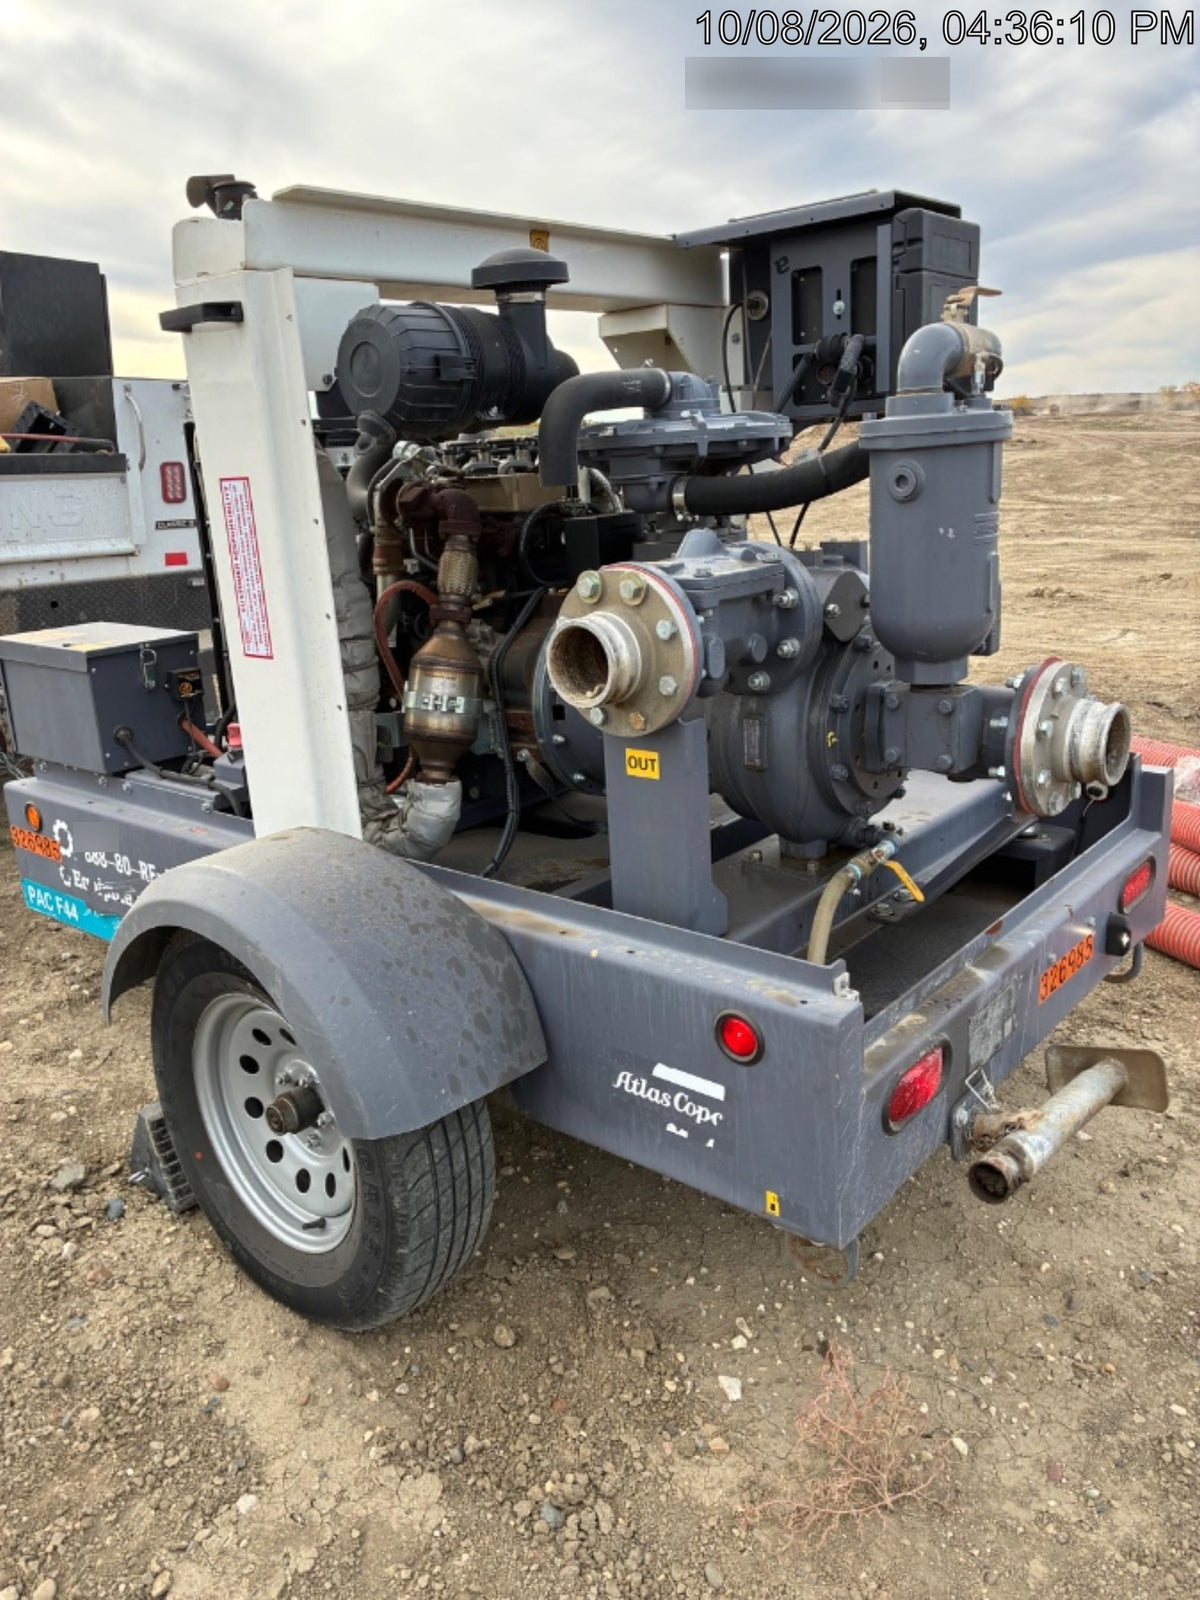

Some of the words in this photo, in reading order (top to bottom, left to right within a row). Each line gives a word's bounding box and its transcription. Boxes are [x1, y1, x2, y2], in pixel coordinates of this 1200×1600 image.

[627, 755, 657, 772] OUT
[11, 826, 60, 860] 326985
[28, 885, 54, 911] PAC
[1041, 934, 1093, 1000] 326985
[612, 1071, 672, 1107] Atlas
